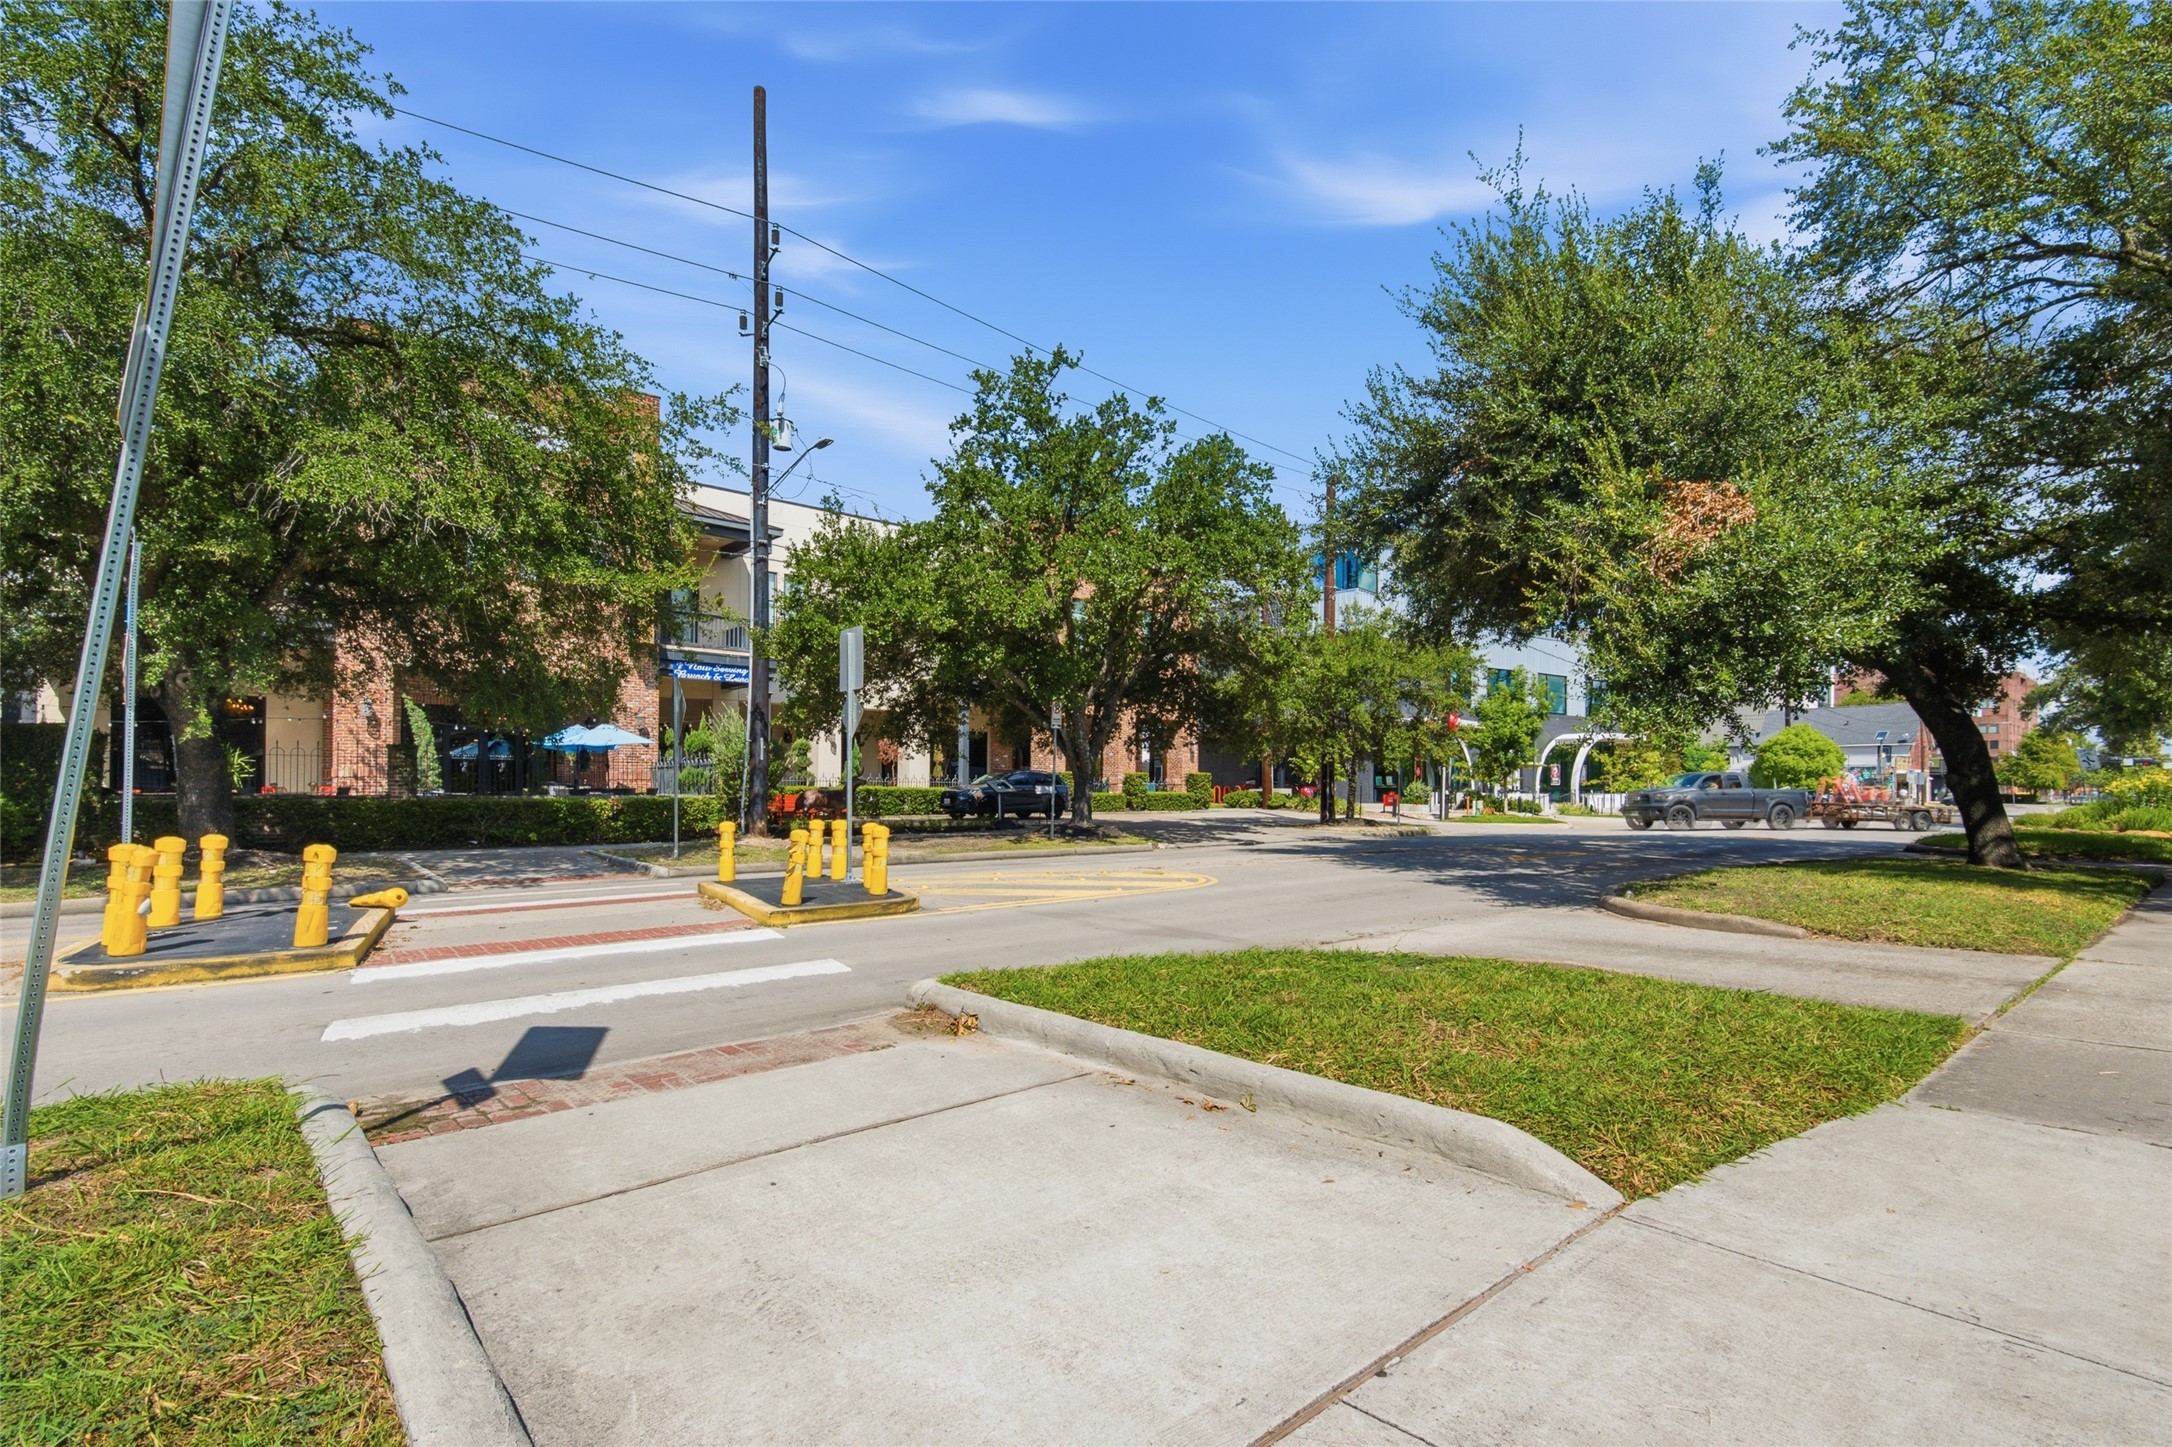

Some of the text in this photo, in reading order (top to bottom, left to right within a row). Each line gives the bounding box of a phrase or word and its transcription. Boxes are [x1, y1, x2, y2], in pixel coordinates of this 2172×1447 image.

[674, 669, 750, 683] Brunch & Lunc
